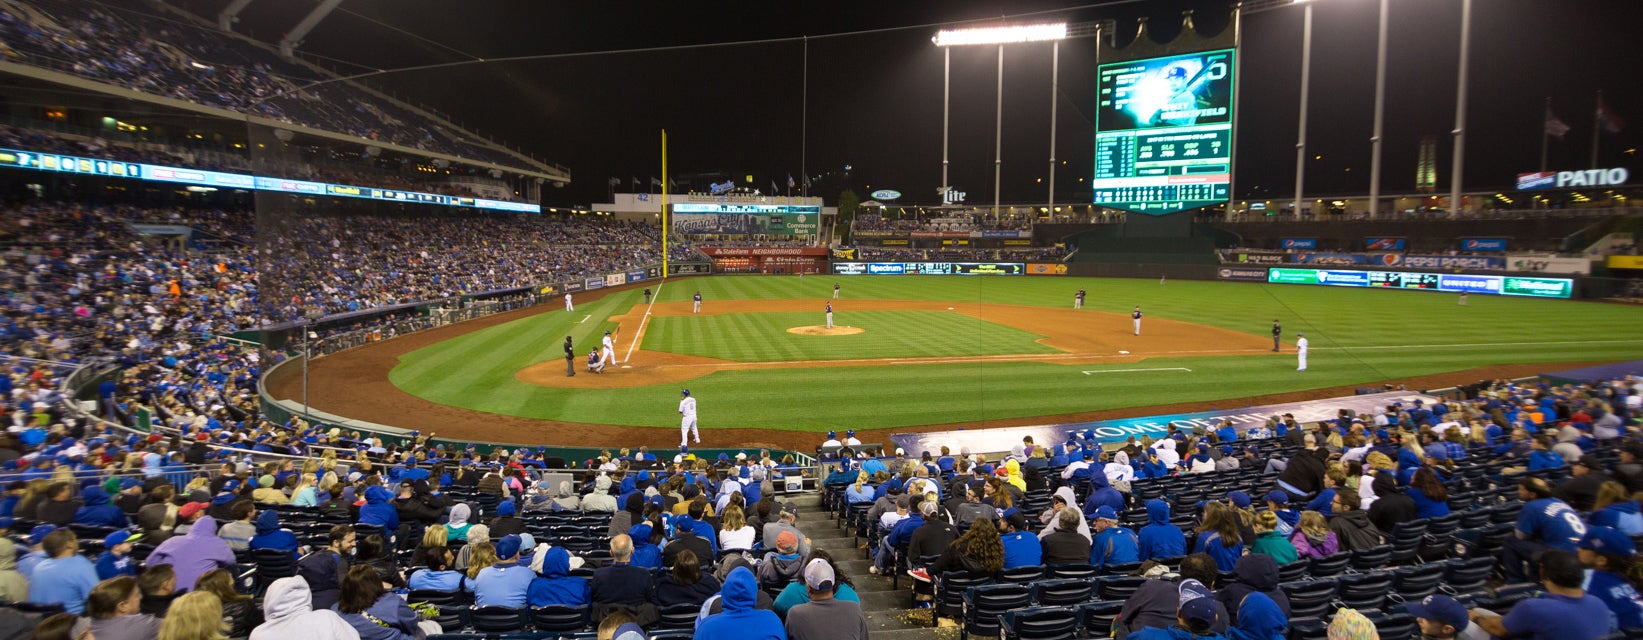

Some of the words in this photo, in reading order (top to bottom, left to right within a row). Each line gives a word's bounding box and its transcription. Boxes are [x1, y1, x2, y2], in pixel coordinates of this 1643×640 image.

[1556, 167, 1628, 187] PATIO
[637, 193, 649, 201] 42
[943, 189, 967, 204] Lite
[675, 215, 717, 233] Kansas
[870, 264, 903, 273] Spectrum
[1405, 257, 1440, 267] PEPSI
[1441, 257, 1488, 269] PORCH
[1442, 279, 1487, 288] UNITED
[1171, 417, 1210, 430] OF
[1563, 512, 1587, 535] 8
